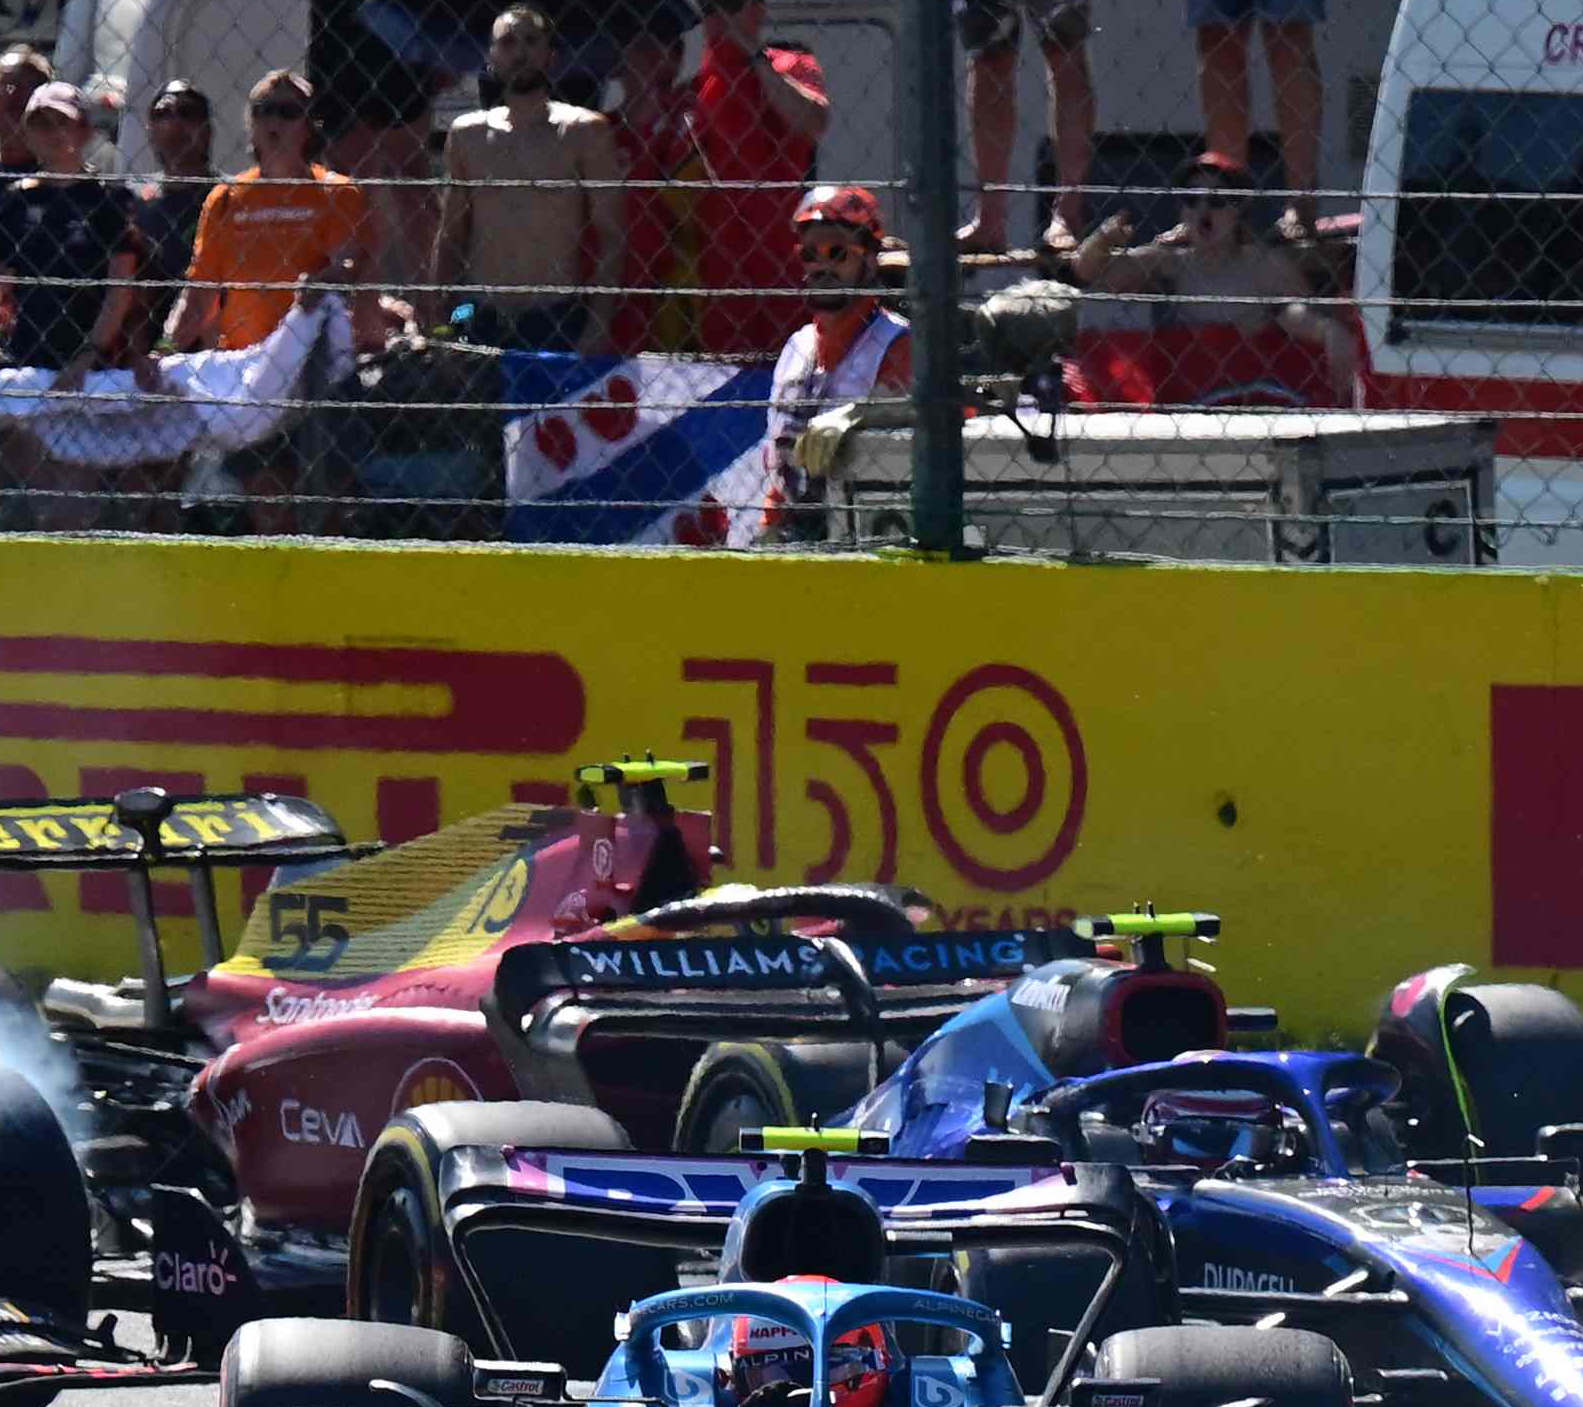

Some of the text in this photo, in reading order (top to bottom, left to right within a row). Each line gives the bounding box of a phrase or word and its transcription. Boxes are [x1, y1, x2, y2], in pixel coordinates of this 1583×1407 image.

[263, 893, 350, 971] 55
[582, 938, 1026, 978] WILLIAMS ACING
[156, 1248, 226, 1296] Claro
